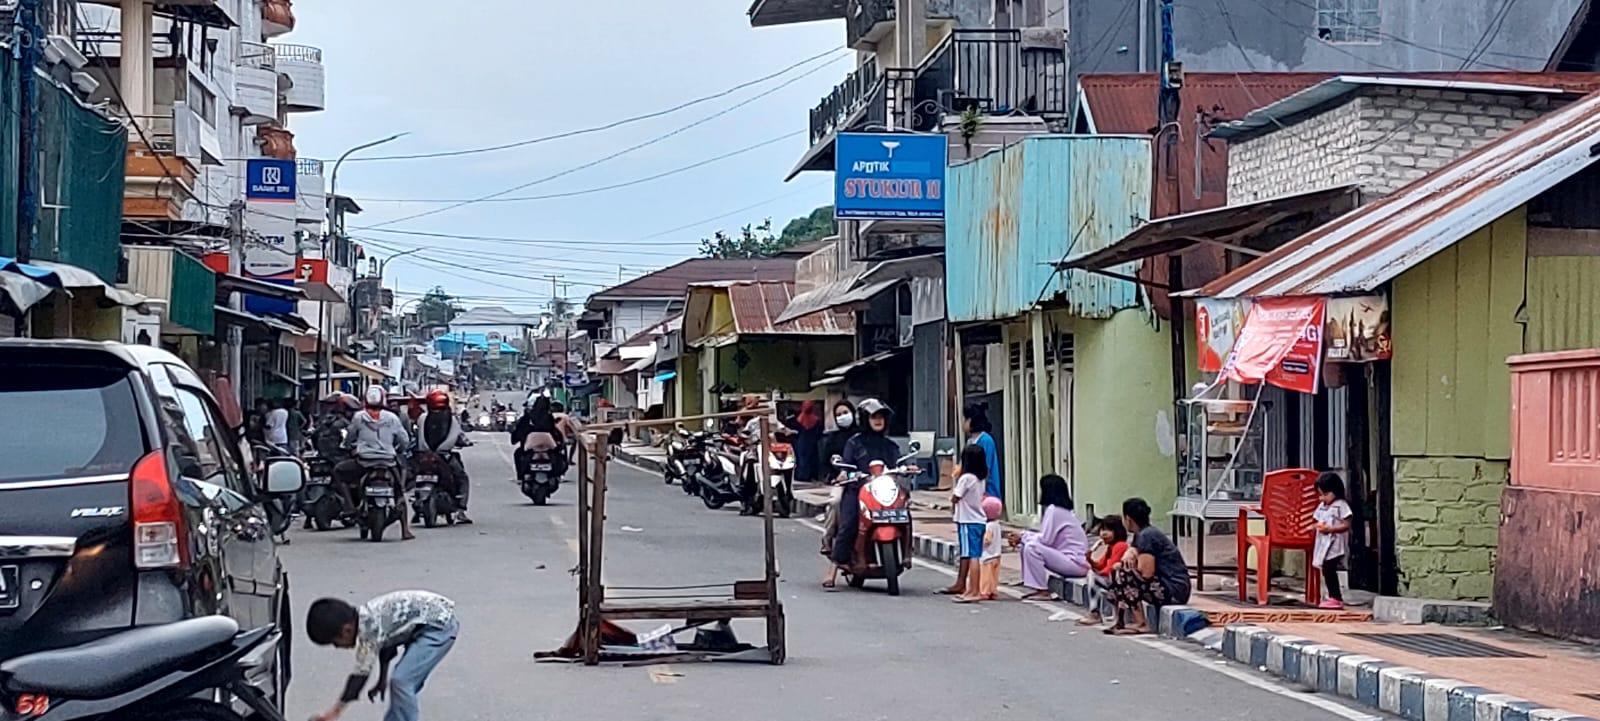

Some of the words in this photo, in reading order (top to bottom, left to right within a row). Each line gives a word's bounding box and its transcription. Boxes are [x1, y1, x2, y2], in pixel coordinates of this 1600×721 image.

[852, 161, 890, 173] APOTIK
[252, 185, 275, 193] BANK
[844, 178, 922, 199] SYUKUR
